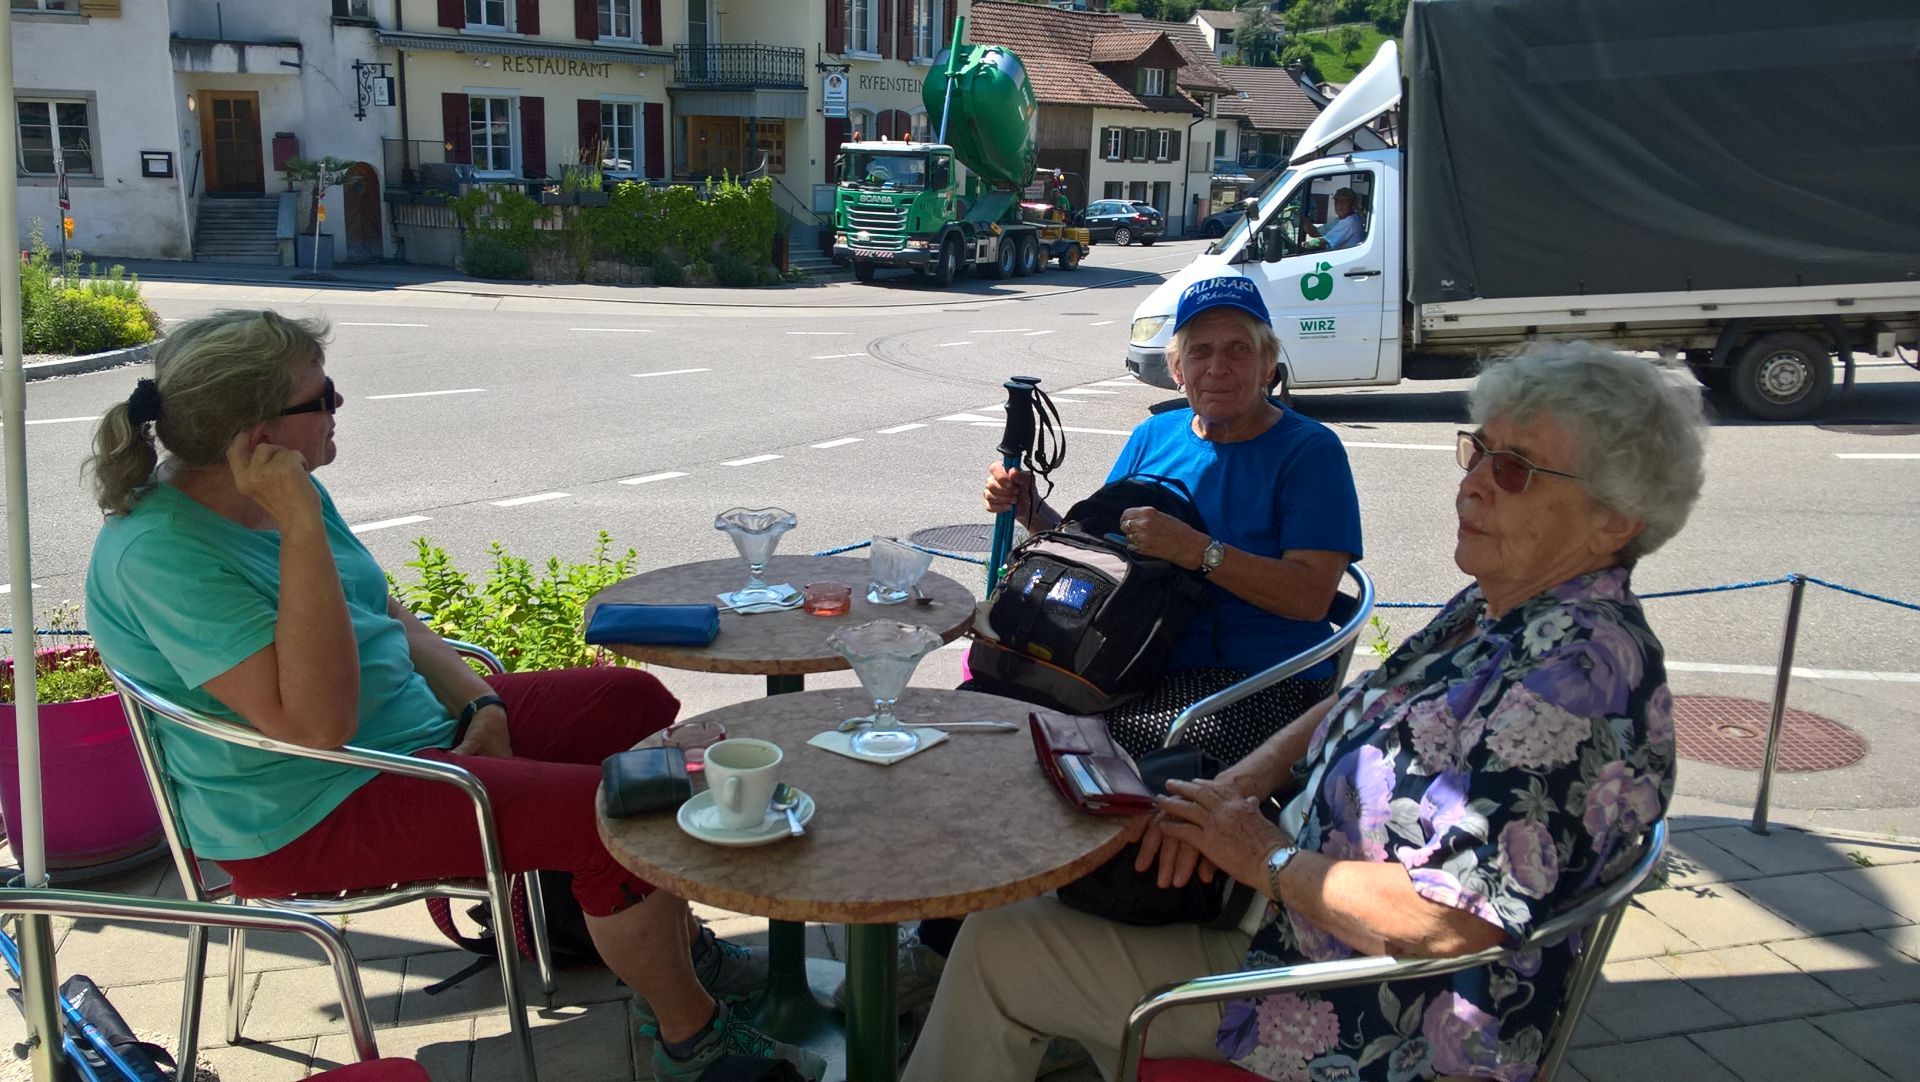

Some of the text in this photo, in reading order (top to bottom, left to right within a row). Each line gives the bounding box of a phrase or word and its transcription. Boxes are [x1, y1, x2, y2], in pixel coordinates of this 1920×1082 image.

[502, 55, 612, 78] RESTAURANT
[859, 195, 893, 204] SCANIA
[1184, 277, 1255, 300] FALIRAKI
[1300, 320, 1336, 331] WIRZ
